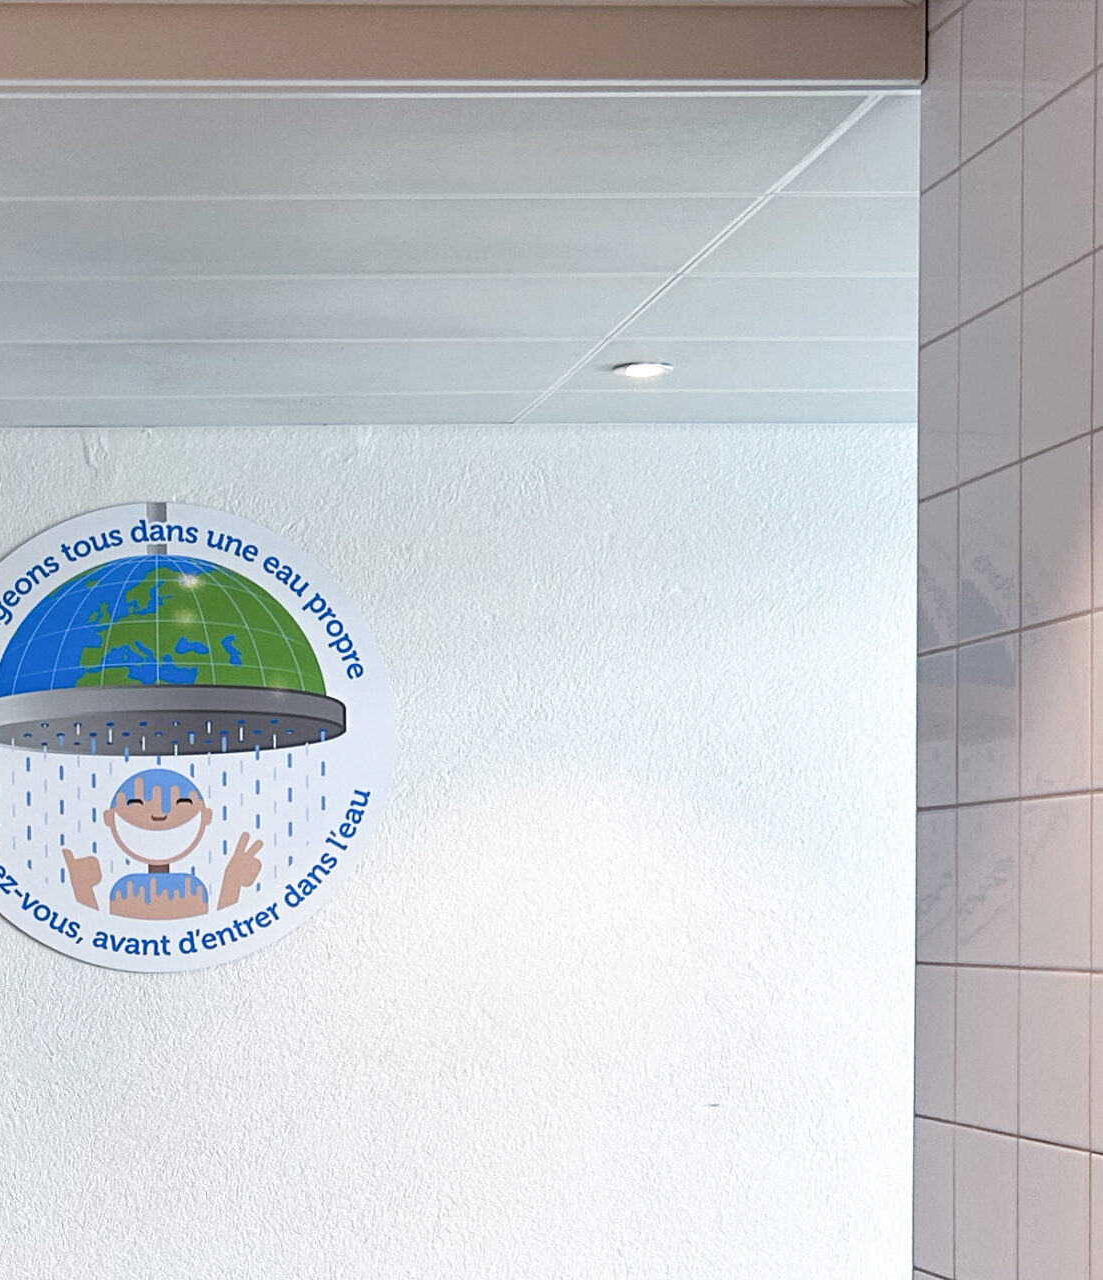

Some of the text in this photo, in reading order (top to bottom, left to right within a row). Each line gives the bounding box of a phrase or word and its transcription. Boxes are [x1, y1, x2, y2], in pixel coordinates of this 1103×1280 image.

[61, 529, 124, 563] tous
[131, 519, 198, 543] dans
[207, 529, 260, 562] une
[263, 556, 309, 597] eau
[303, 586, 364, 680] propre
[93, 931, 171, 957] avant
[179, 904, 281, 955] d'entrer
[283, 852, 338, 908] dans
[326, 789, 371, 852] l'eau
